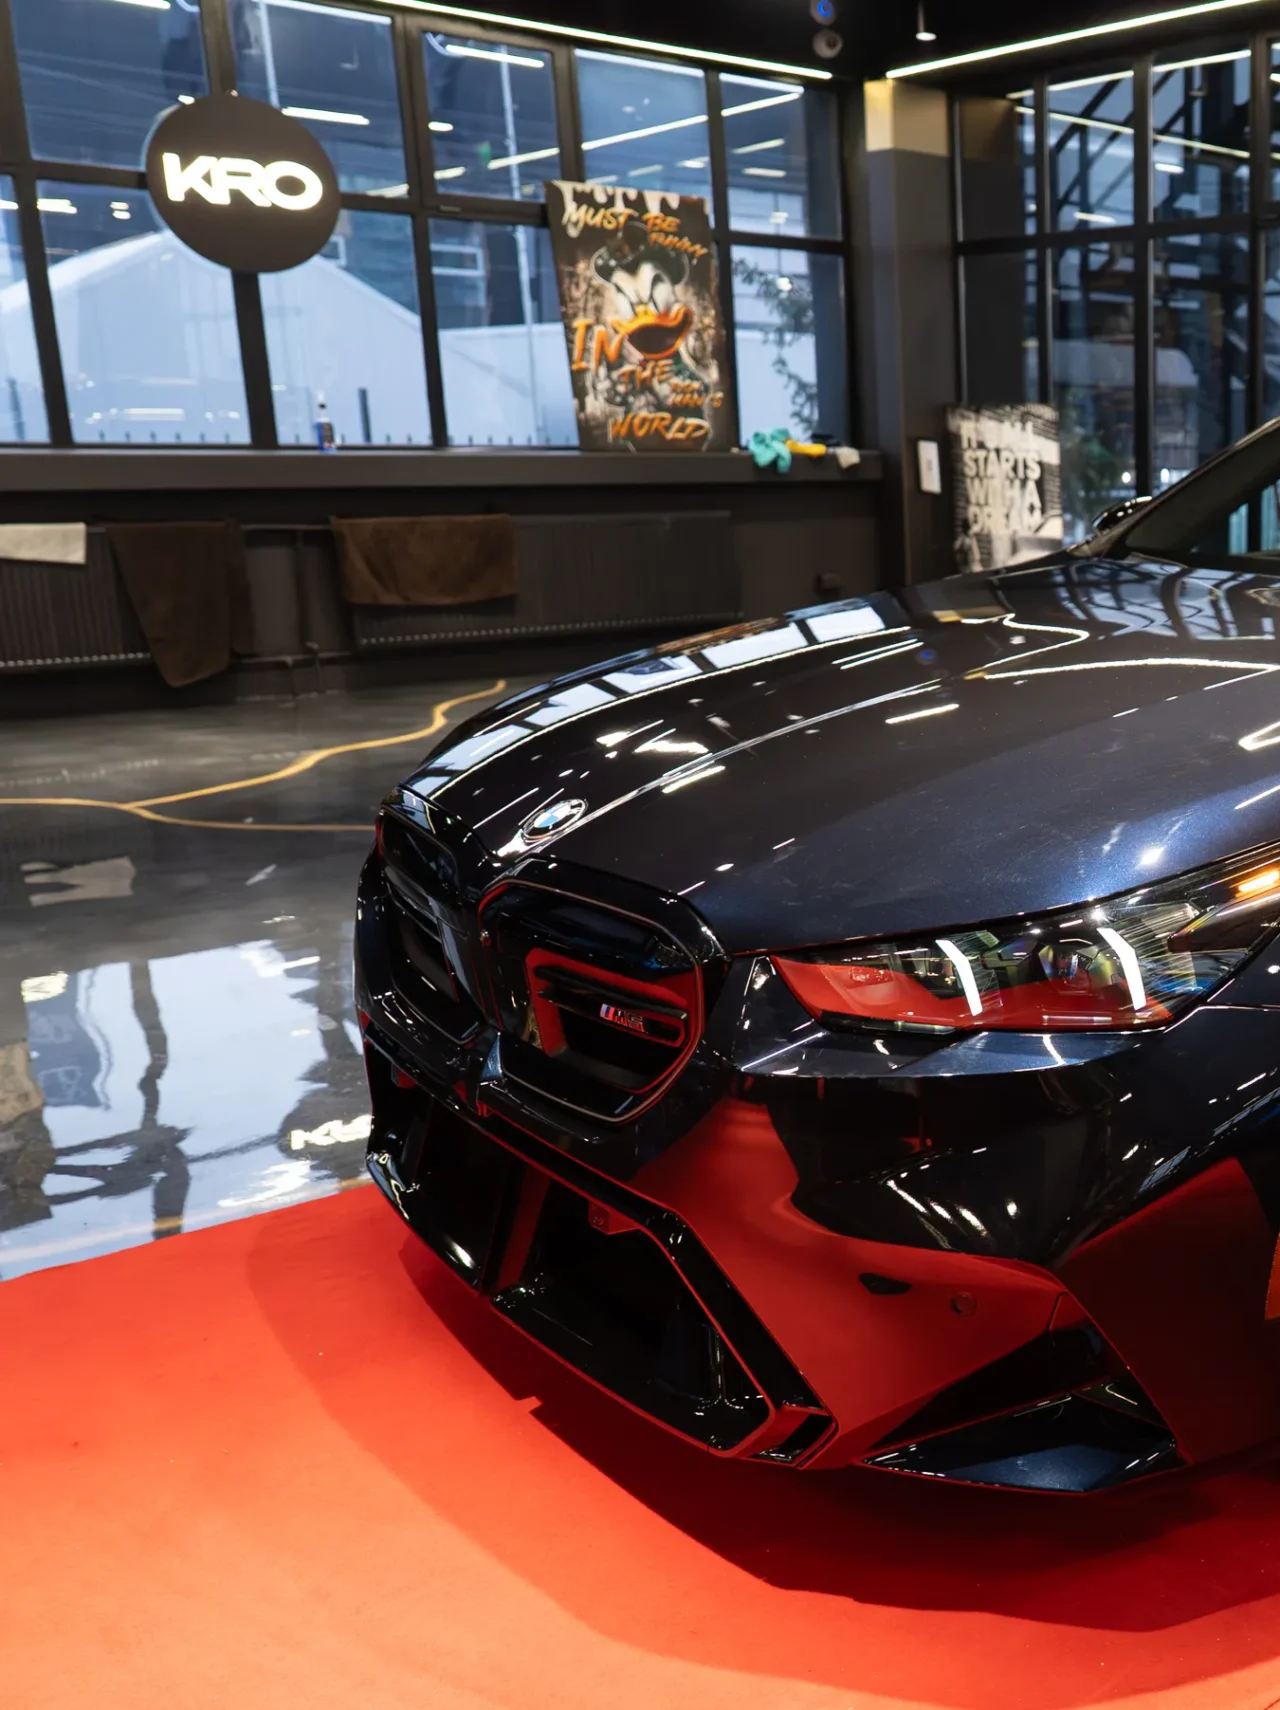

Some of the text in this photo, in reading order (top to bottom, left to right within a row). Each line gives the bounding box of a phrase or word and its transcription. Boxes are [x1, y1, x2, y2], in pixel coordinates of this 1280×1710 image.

[162, 152, 323, 210] KRO
[561, 204, 681, 234] MUST BE
[571, 318, 627, 375] IN
[615, 360, 674, 391] THE
[609, 411, 711, 443] WORLD
[963, 449, 1041, 480] STARTS
